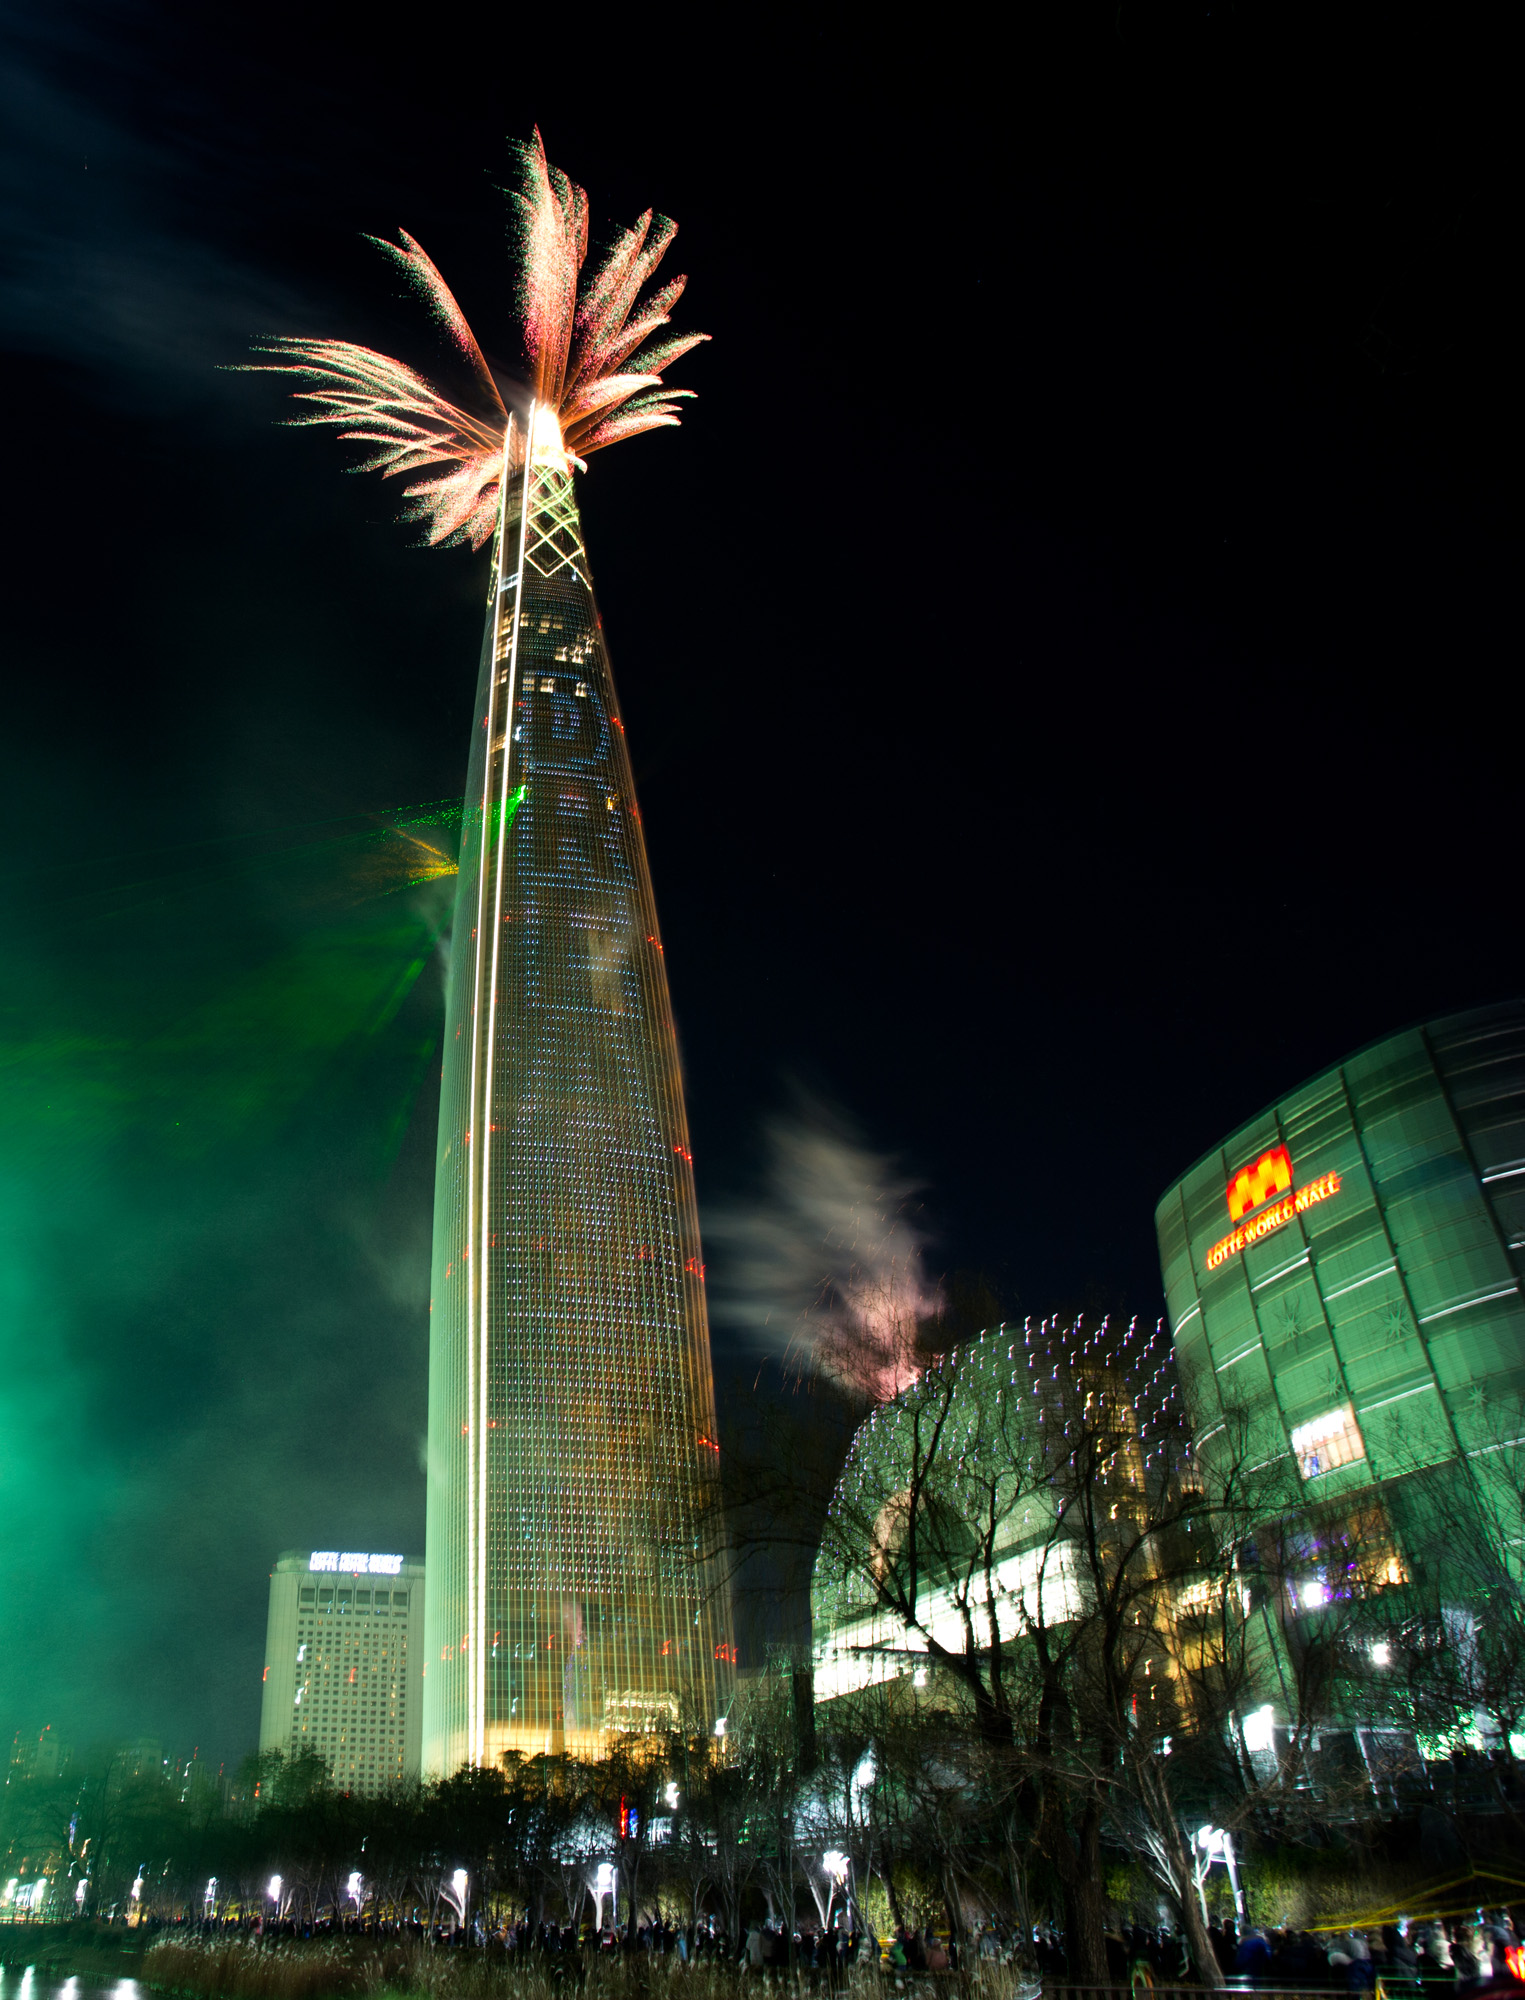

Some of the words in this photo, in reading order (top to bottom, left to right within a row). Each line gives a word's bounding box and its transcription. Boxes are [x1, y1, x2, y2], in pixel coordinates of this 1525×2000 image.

[1206, 1228, 1246, 1270] LOTTE
[1244, 1200, 1295, 1243] WORLD
[1294, 1174, 1341, 1213] MALL
